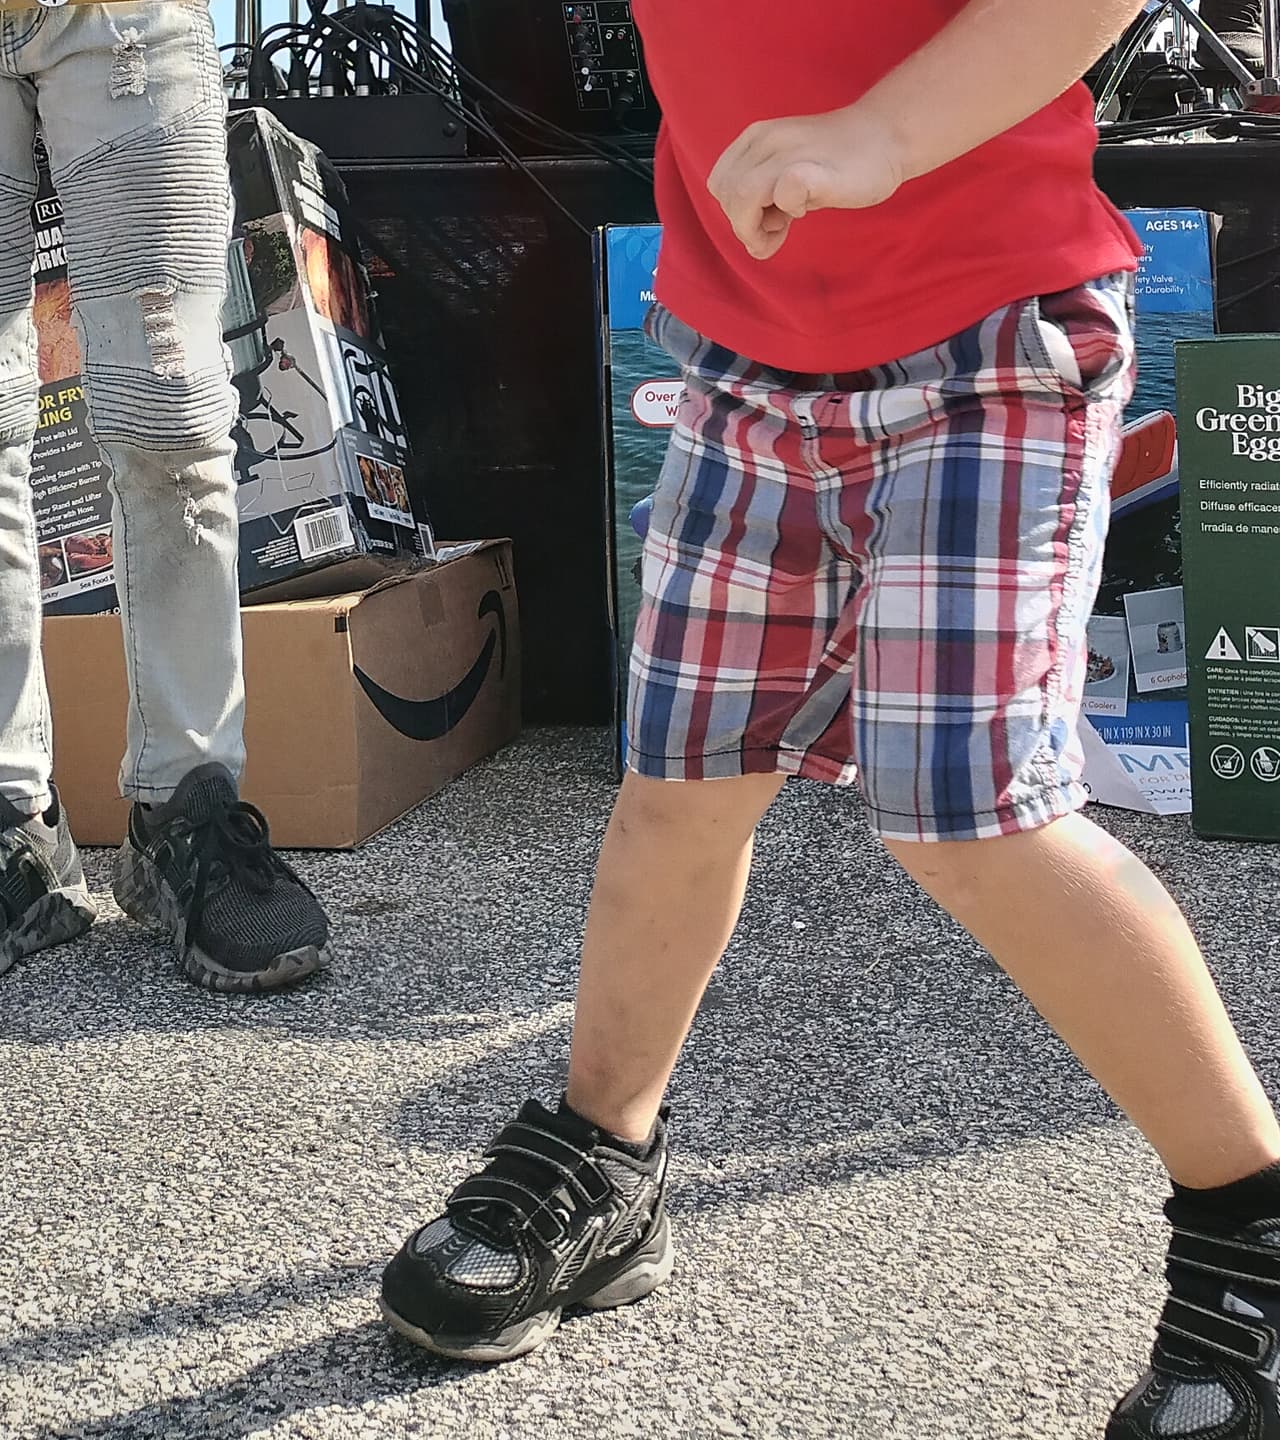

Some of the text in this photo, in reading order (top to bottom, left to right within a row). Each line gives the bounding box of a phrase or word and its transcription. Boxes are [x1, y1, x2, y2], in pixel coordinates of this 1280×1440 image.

[1145, 219, 1200, 231] AGES 14+
[1151, 274, 1173, 283] Valve
[1145, 286, 1184, 295] Durability
[644, 391, 676, 402] Over
[32, 440, 83, 461] Provides Safer
[30, 473, 58, 486] Cooking
[57, 467, 77, 479] Stand
[77, 463, 91, 473] with
[1199, 479, 1248, 493] Efficiently
[77, 505, 94, 515] Hose
[1200, 500, 1235, 511] Diffuse
[56, 514, 100, 532] Thermometer
[1201, 522, 1233, 533] Irradia
[1235, 523, 1249, 533] de
[79, 576, 109, 590] Sea Food
[1088, 700, 1117, 710] Coolers
[1104, 725, 1171, 739] IN X 119 IN X 30 IN
